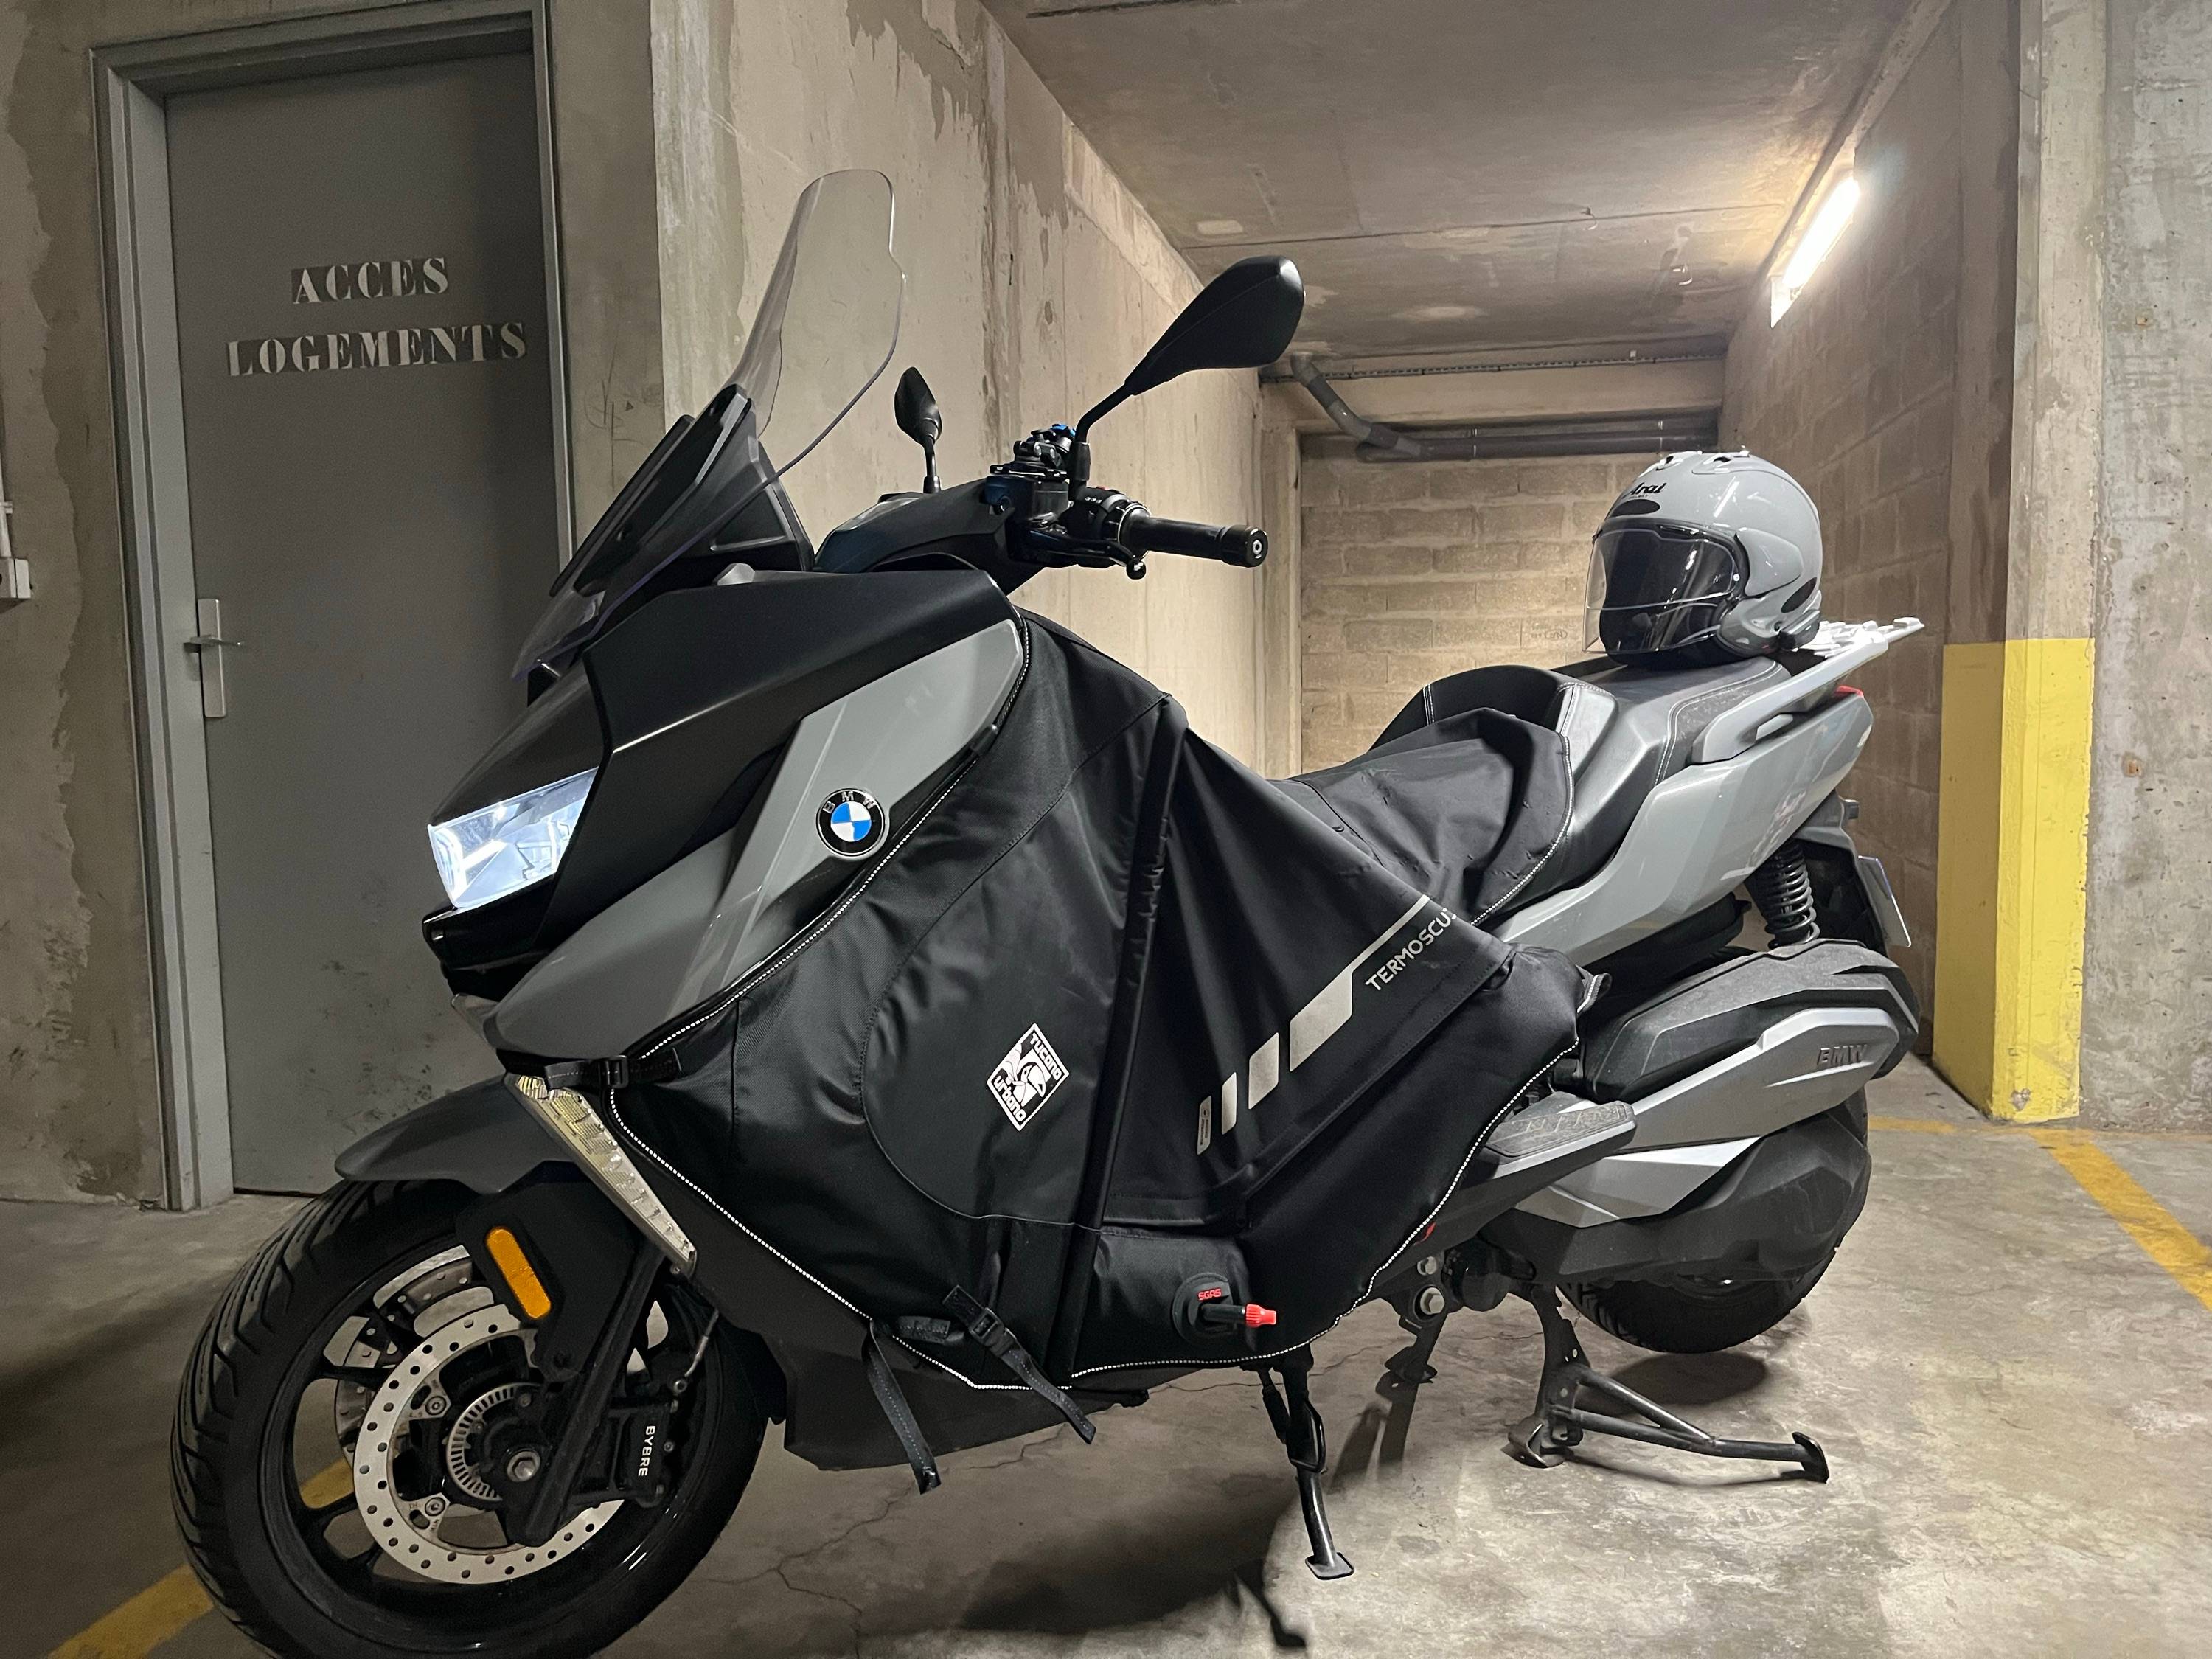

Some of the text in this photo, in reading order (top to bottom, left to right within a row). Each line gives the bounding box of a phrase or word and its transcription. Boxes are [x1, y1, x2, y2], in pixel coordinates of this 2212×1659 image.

[293, 257, 449, 305] ACCES
[228, 322, 526, 377] LOGEMENTS
[822, 790, 876, 814] BMW
[1365, 908, 1457, 991] TERMOSCU
[1817, 1043, 1868, 1066] BMW
[638, 1425, 656, 1477] BYBRE
